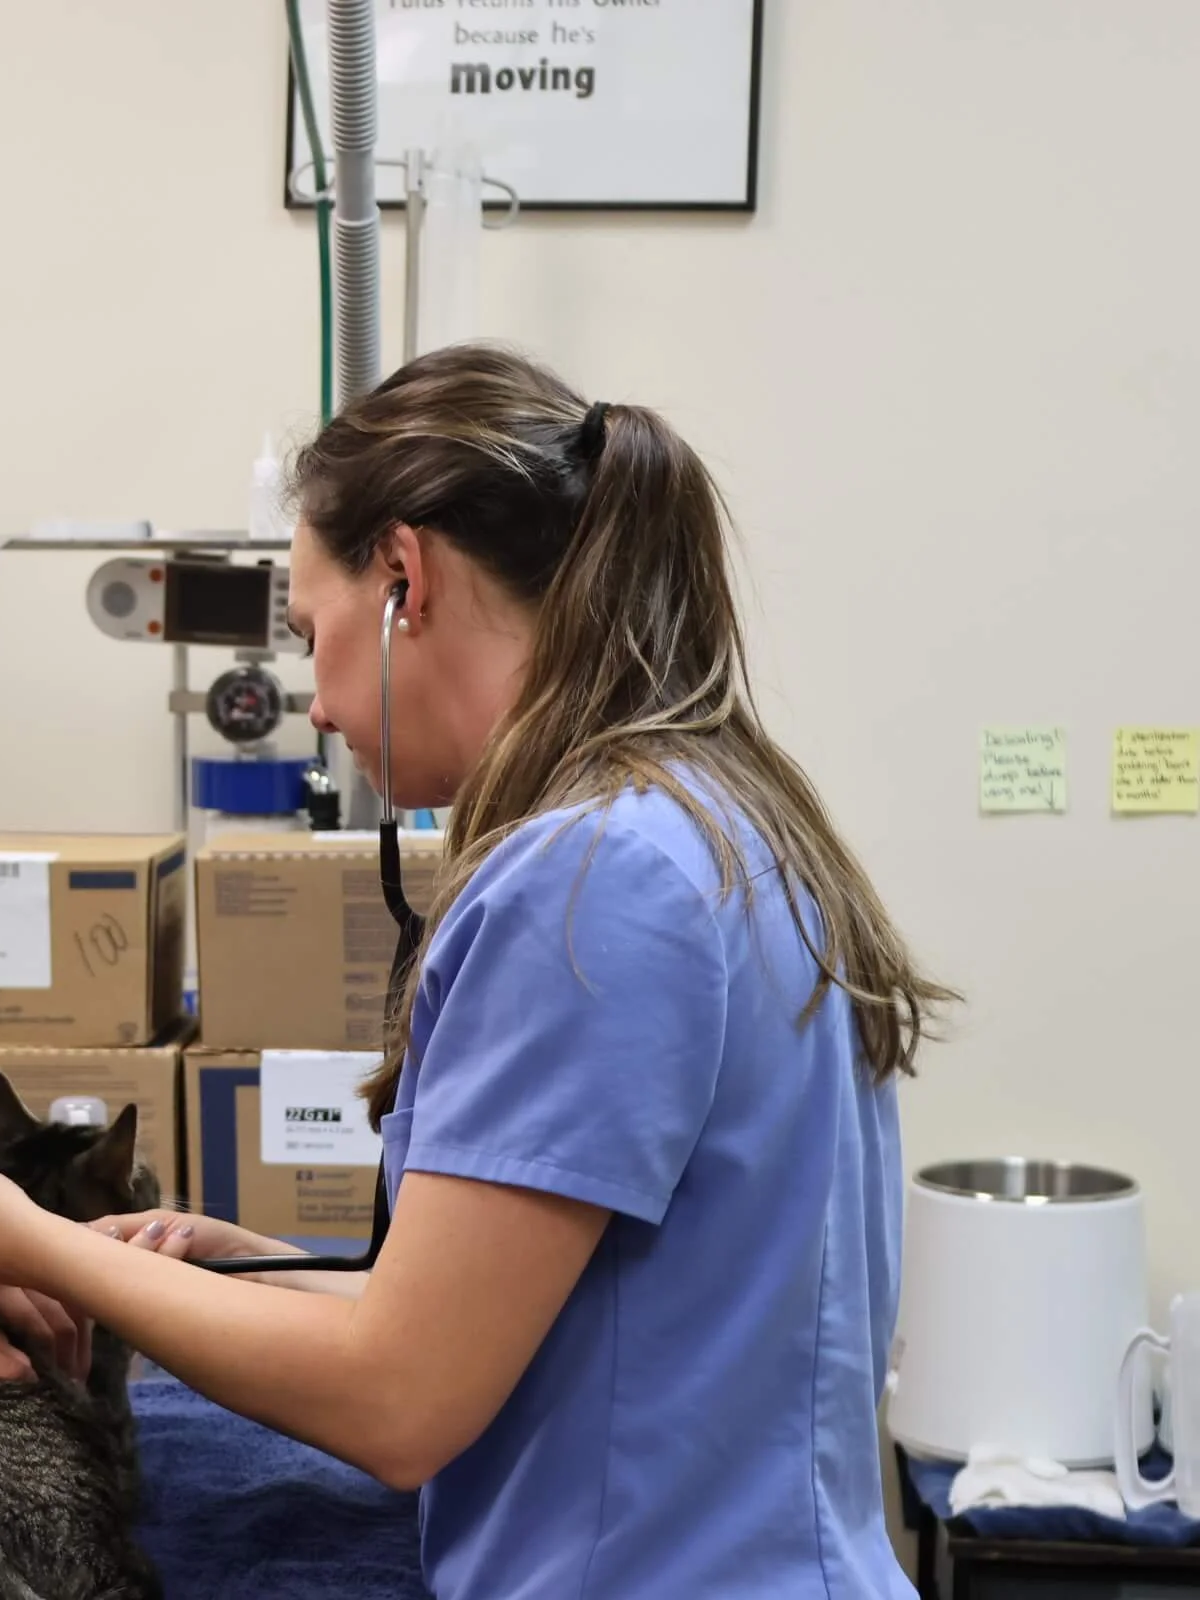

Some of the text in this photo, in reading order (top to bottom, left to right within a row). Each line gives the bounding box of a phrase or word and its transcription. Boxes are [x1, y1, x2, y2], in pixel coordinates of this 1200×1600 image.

[454, 20, 596, 45] because he's
[450, 56, 596, 98] moving
[73, 912, 129, 978] 100
